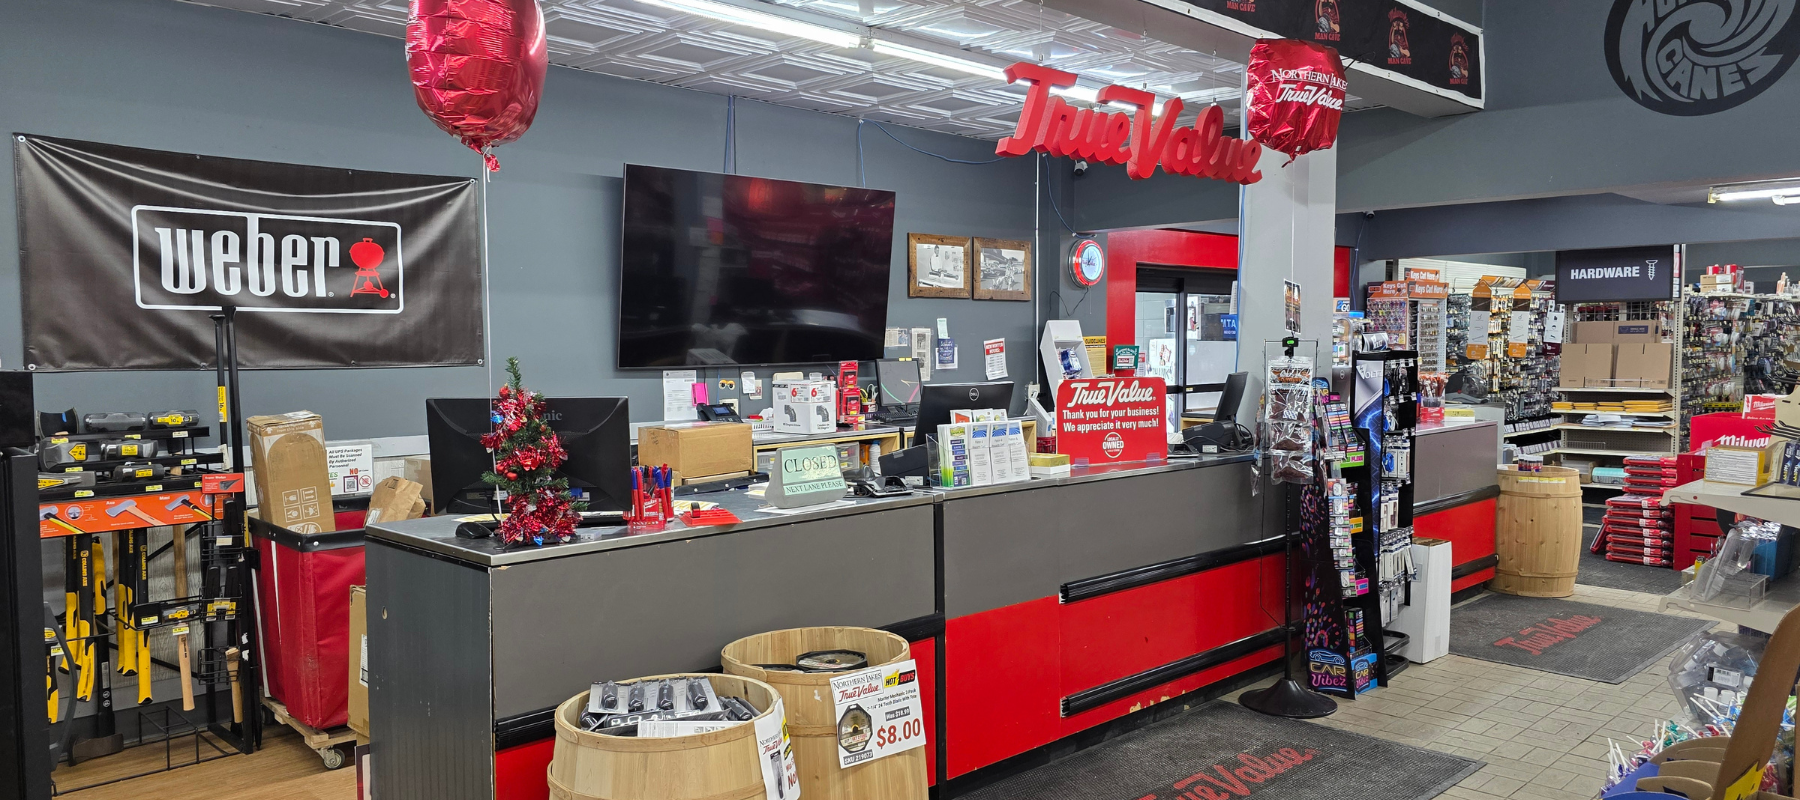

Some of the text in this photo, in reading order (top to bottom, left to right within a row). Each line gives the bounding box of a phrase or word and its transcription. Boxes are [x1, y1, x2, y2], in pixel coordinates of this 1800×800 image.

[1227, 1, 1256, 12] MAN CAVE
[1315, 31, 1341, 41] MAN CAVE
[1388, 57, 1400, 65] MAN
[1271, 67, 1330, 84] NORTHERN
[154, 214, 340, 297] weber
[1410, 271, 1420, 281] Keys
[1427, 271, 1435, 280] Here
[1570, 266, 1640, 280] HARDWARE
[1415, 284, 1426, 294] Keys
[1433, 285, 1443, 294] Here
[791, 387, 797, 398] 6
[811, 387, 817, 398] 6
[1063, 406, 1159, 420] Thank you for your business!
[1063, 418, 1159, 434] We appreciate it very much!
[1102, 441, 1124, 450] OWNED
[784, 455, 837, 473] CLOSED
[349, 467, 359, 475] NO
[786, 480, 843, 493] NEXT LANE PLEASE
[1309, 661, 1347, 677] CAR
[1355, 669, 1369, 680] CAR
[833, 672, 882, 691] NORTHERN LAKES
[885, 672, 915, 687] HOT BUYS
[876, 717, 921, 750] $8.00
[844, 755, 856, 764] SKU
